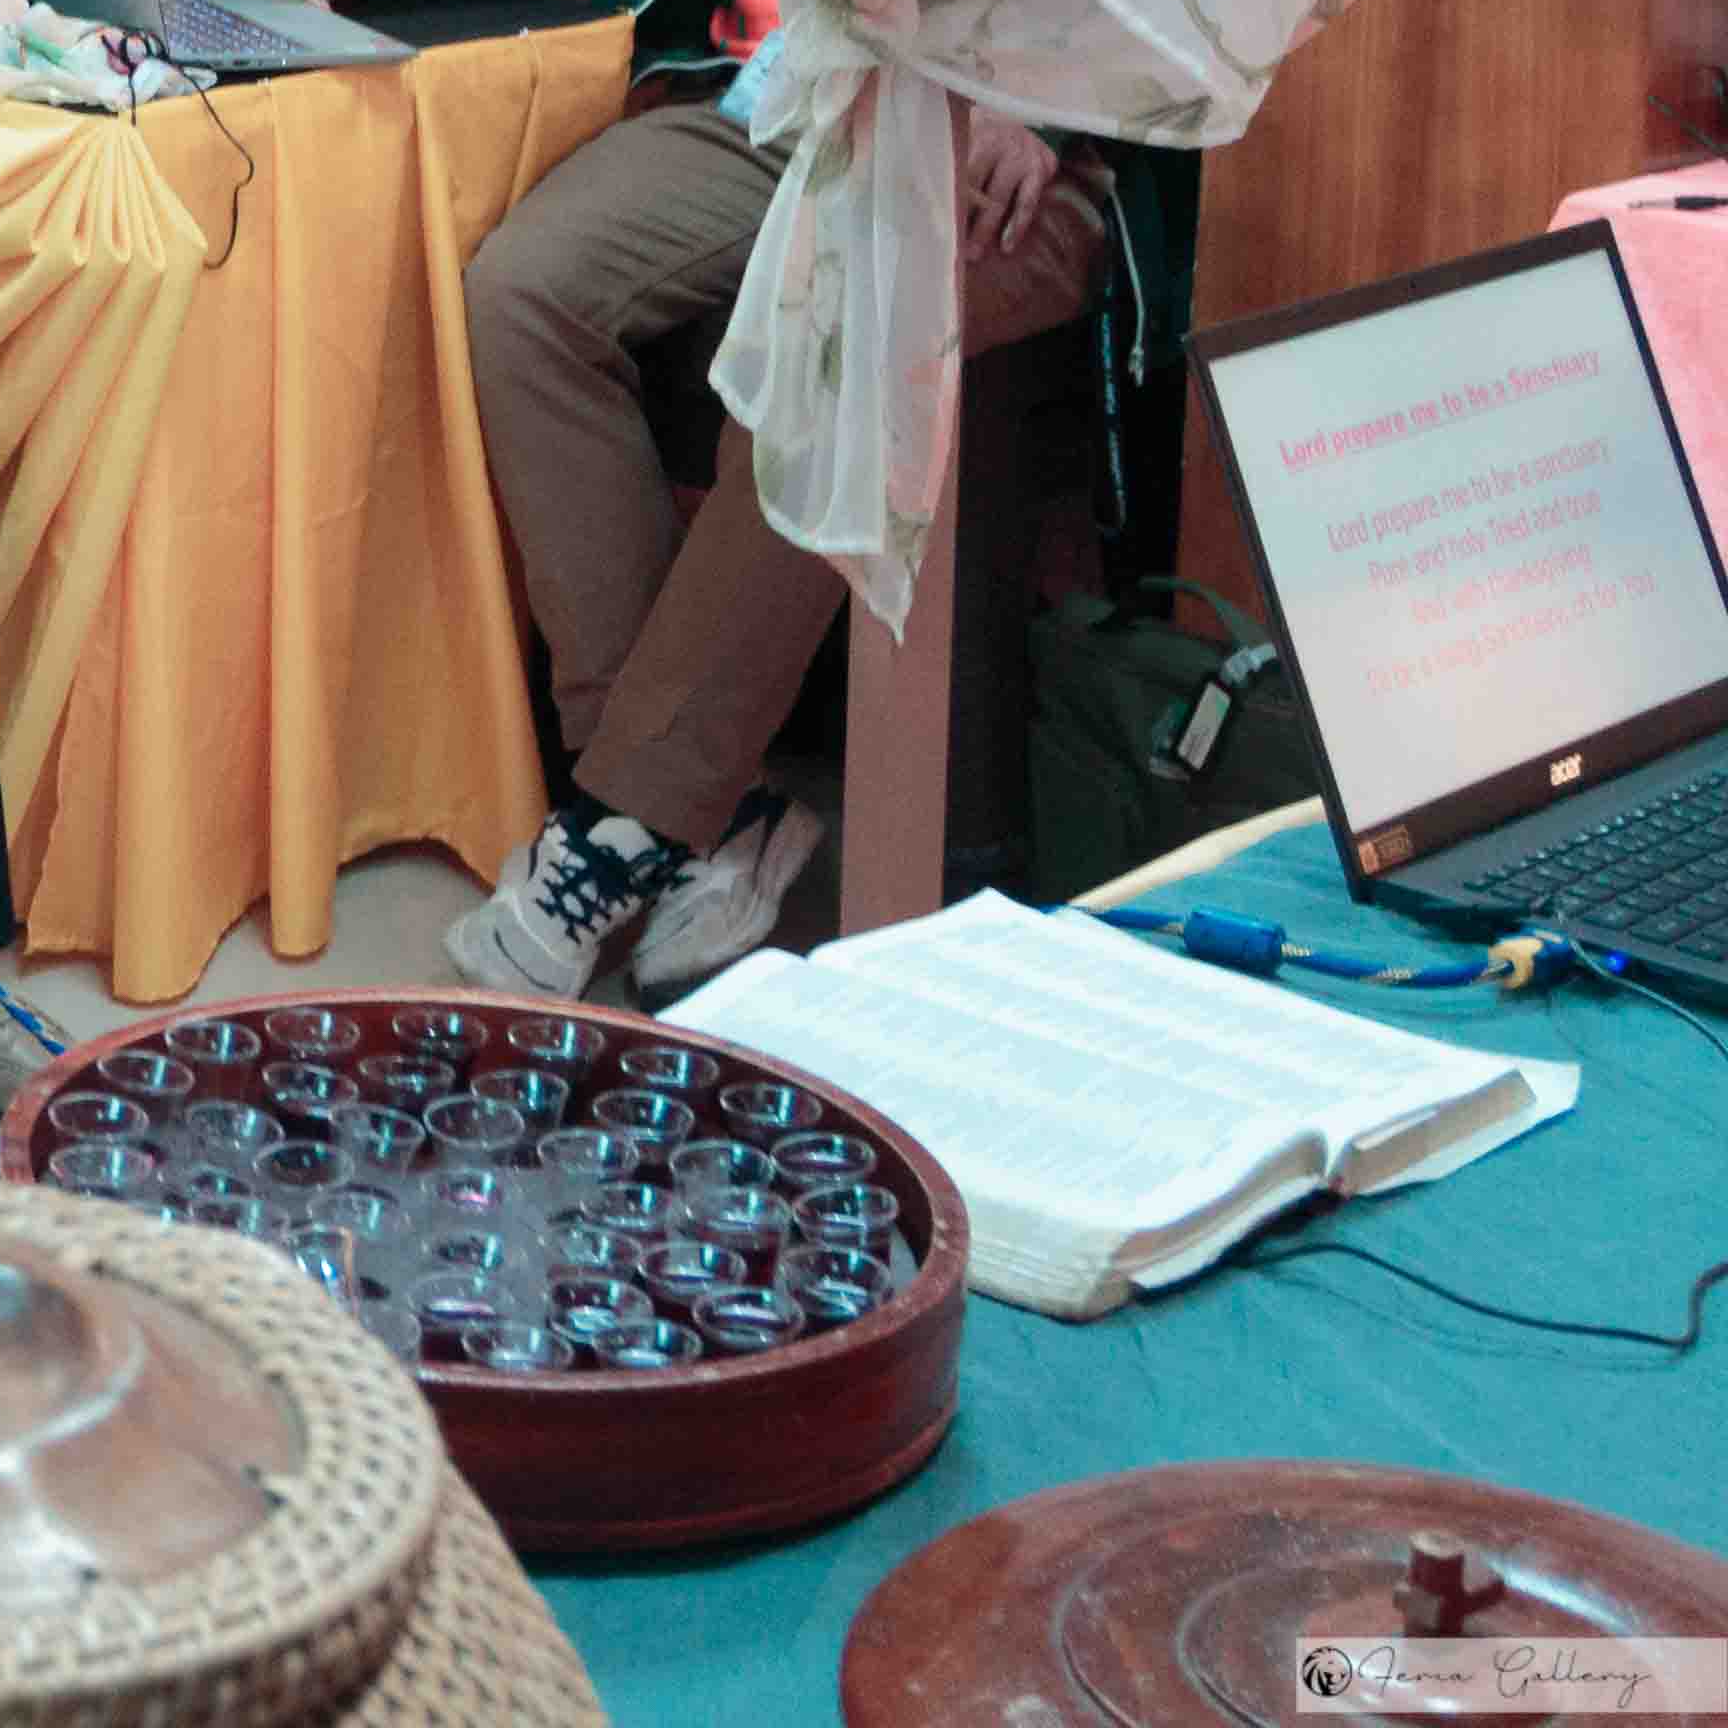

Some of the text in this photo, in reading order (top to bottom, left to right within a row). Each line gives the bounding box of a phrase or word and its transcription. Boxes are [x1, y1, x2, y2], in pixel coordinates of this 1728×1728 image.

[1279, 429, 1327, 469] Lord
[1332, 412, 1407, 457] prepare
[1409, 399, 1440, 429] me
[1327, 511, 1369, 553] Lord
[1372, 494, 1441, 544] prepare
